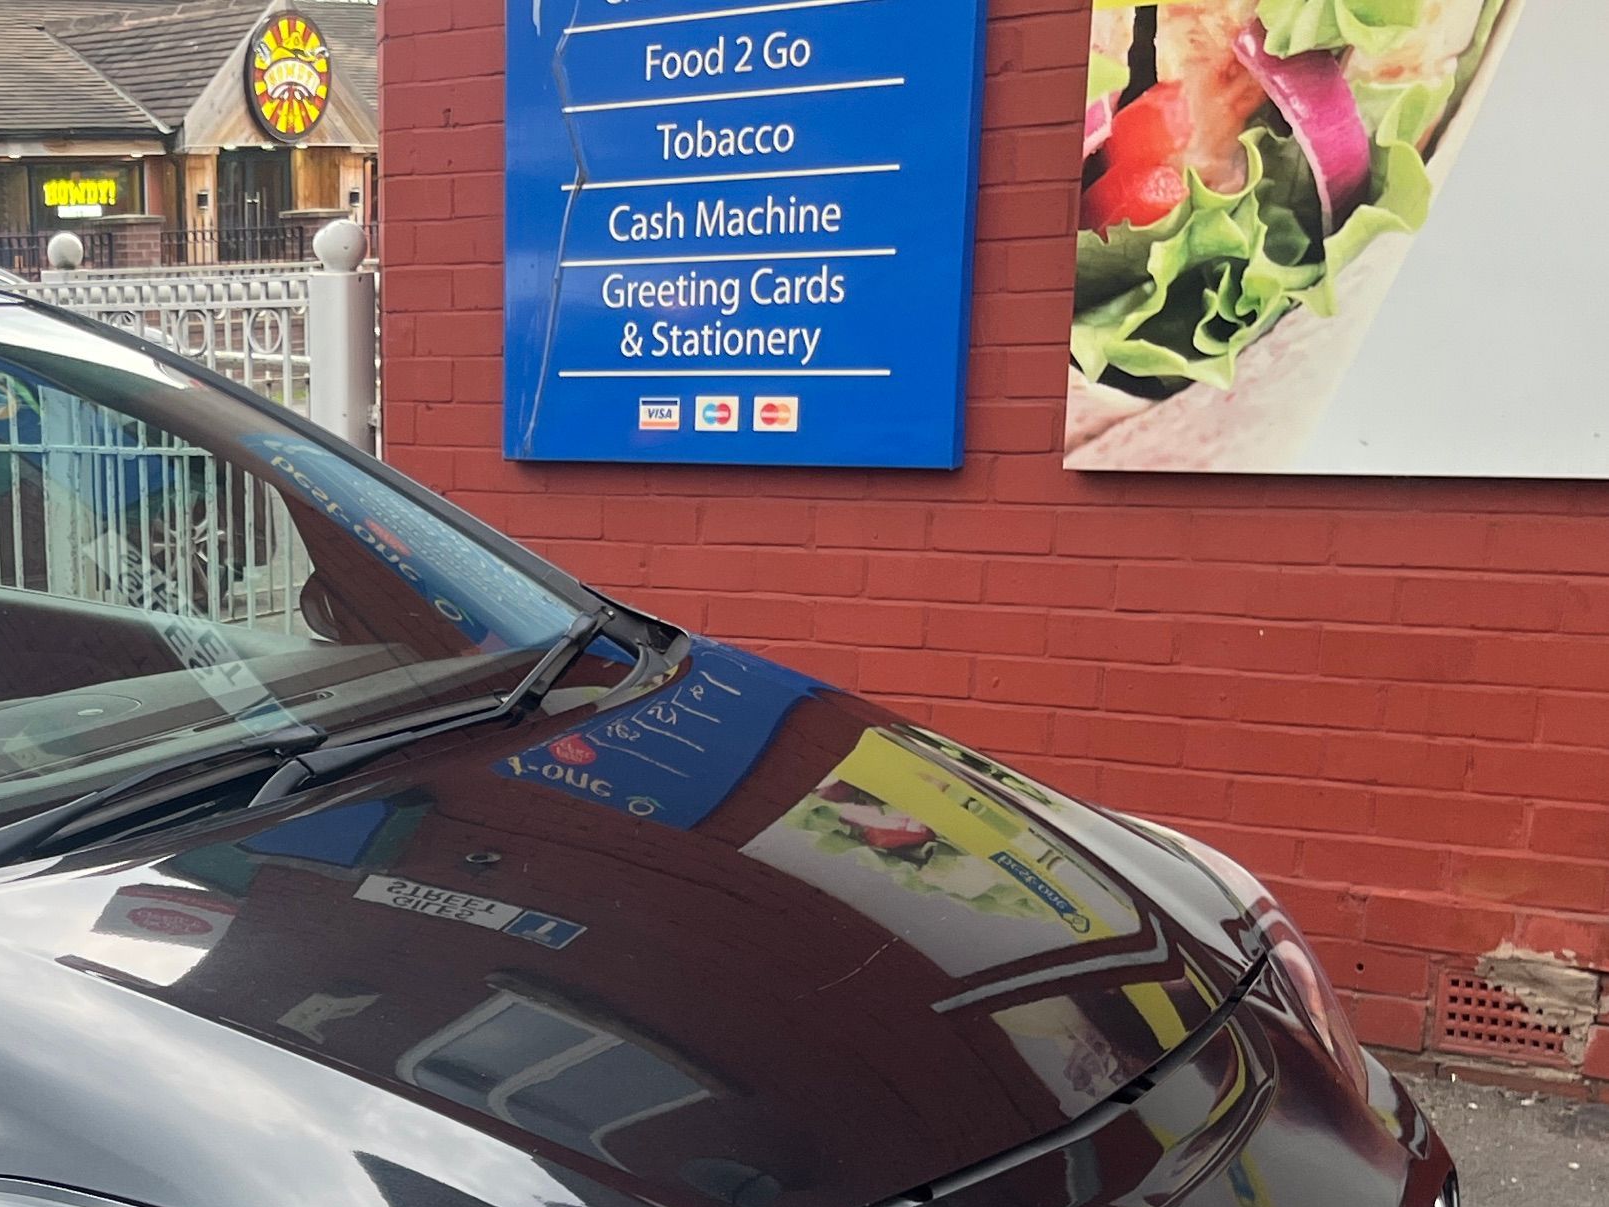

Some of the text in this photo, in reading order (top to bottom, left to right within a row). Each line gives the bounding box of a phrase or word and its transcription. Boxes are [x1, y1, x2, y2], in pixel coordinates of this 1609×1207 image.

[645, 31, 811, 81] Food 2 Go
[656, 120, 795, 160] Tobacco
[43, 179, 116, 206] HOWDY!
[608, 196, 842, 242] Cash Machine
[601, 265, 845, 315] Greeting Cards
[620, 321, 822, 365] & Stationery
[647, 408, 673, 420] VISA
